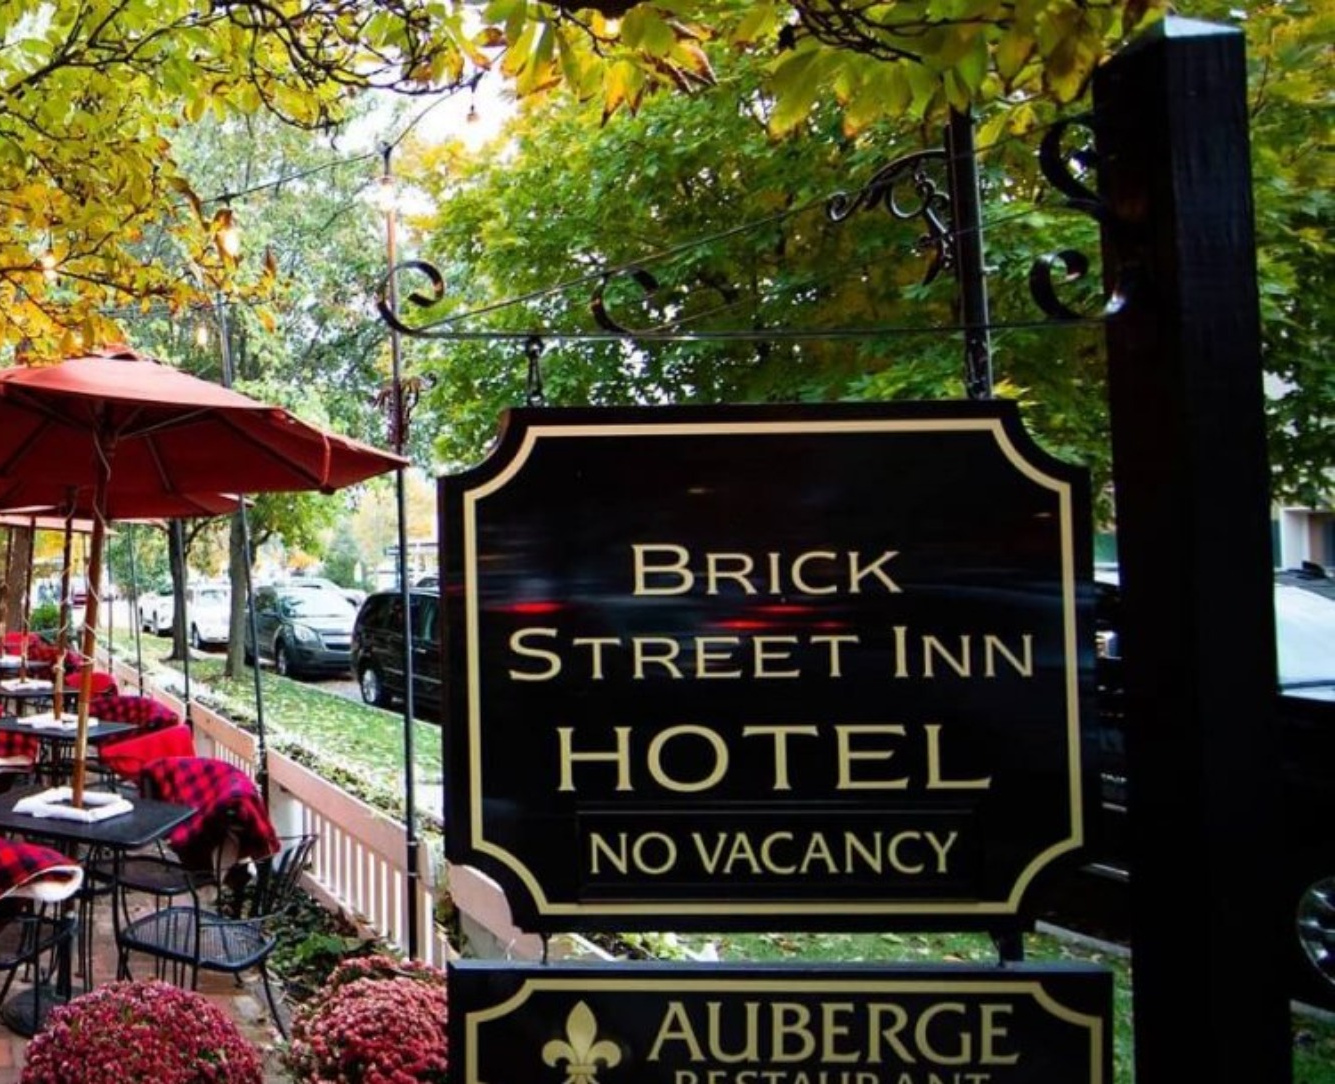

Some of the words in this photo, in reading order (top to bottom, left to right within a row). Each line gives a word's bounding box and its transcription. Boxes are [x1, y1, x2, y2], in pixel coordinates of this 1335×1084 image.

[630, 543, 902, 597] BRICK
[508, 626, 860, 682] STREET
[892, 625, 1033, 679] INN
[556, 723, 992, 793] HOTEL
[589, 831, 678, 875] NO
[691, 830, 958, 875] VACANCY
[647, 1000, 1019, 1065] AUBERGE
